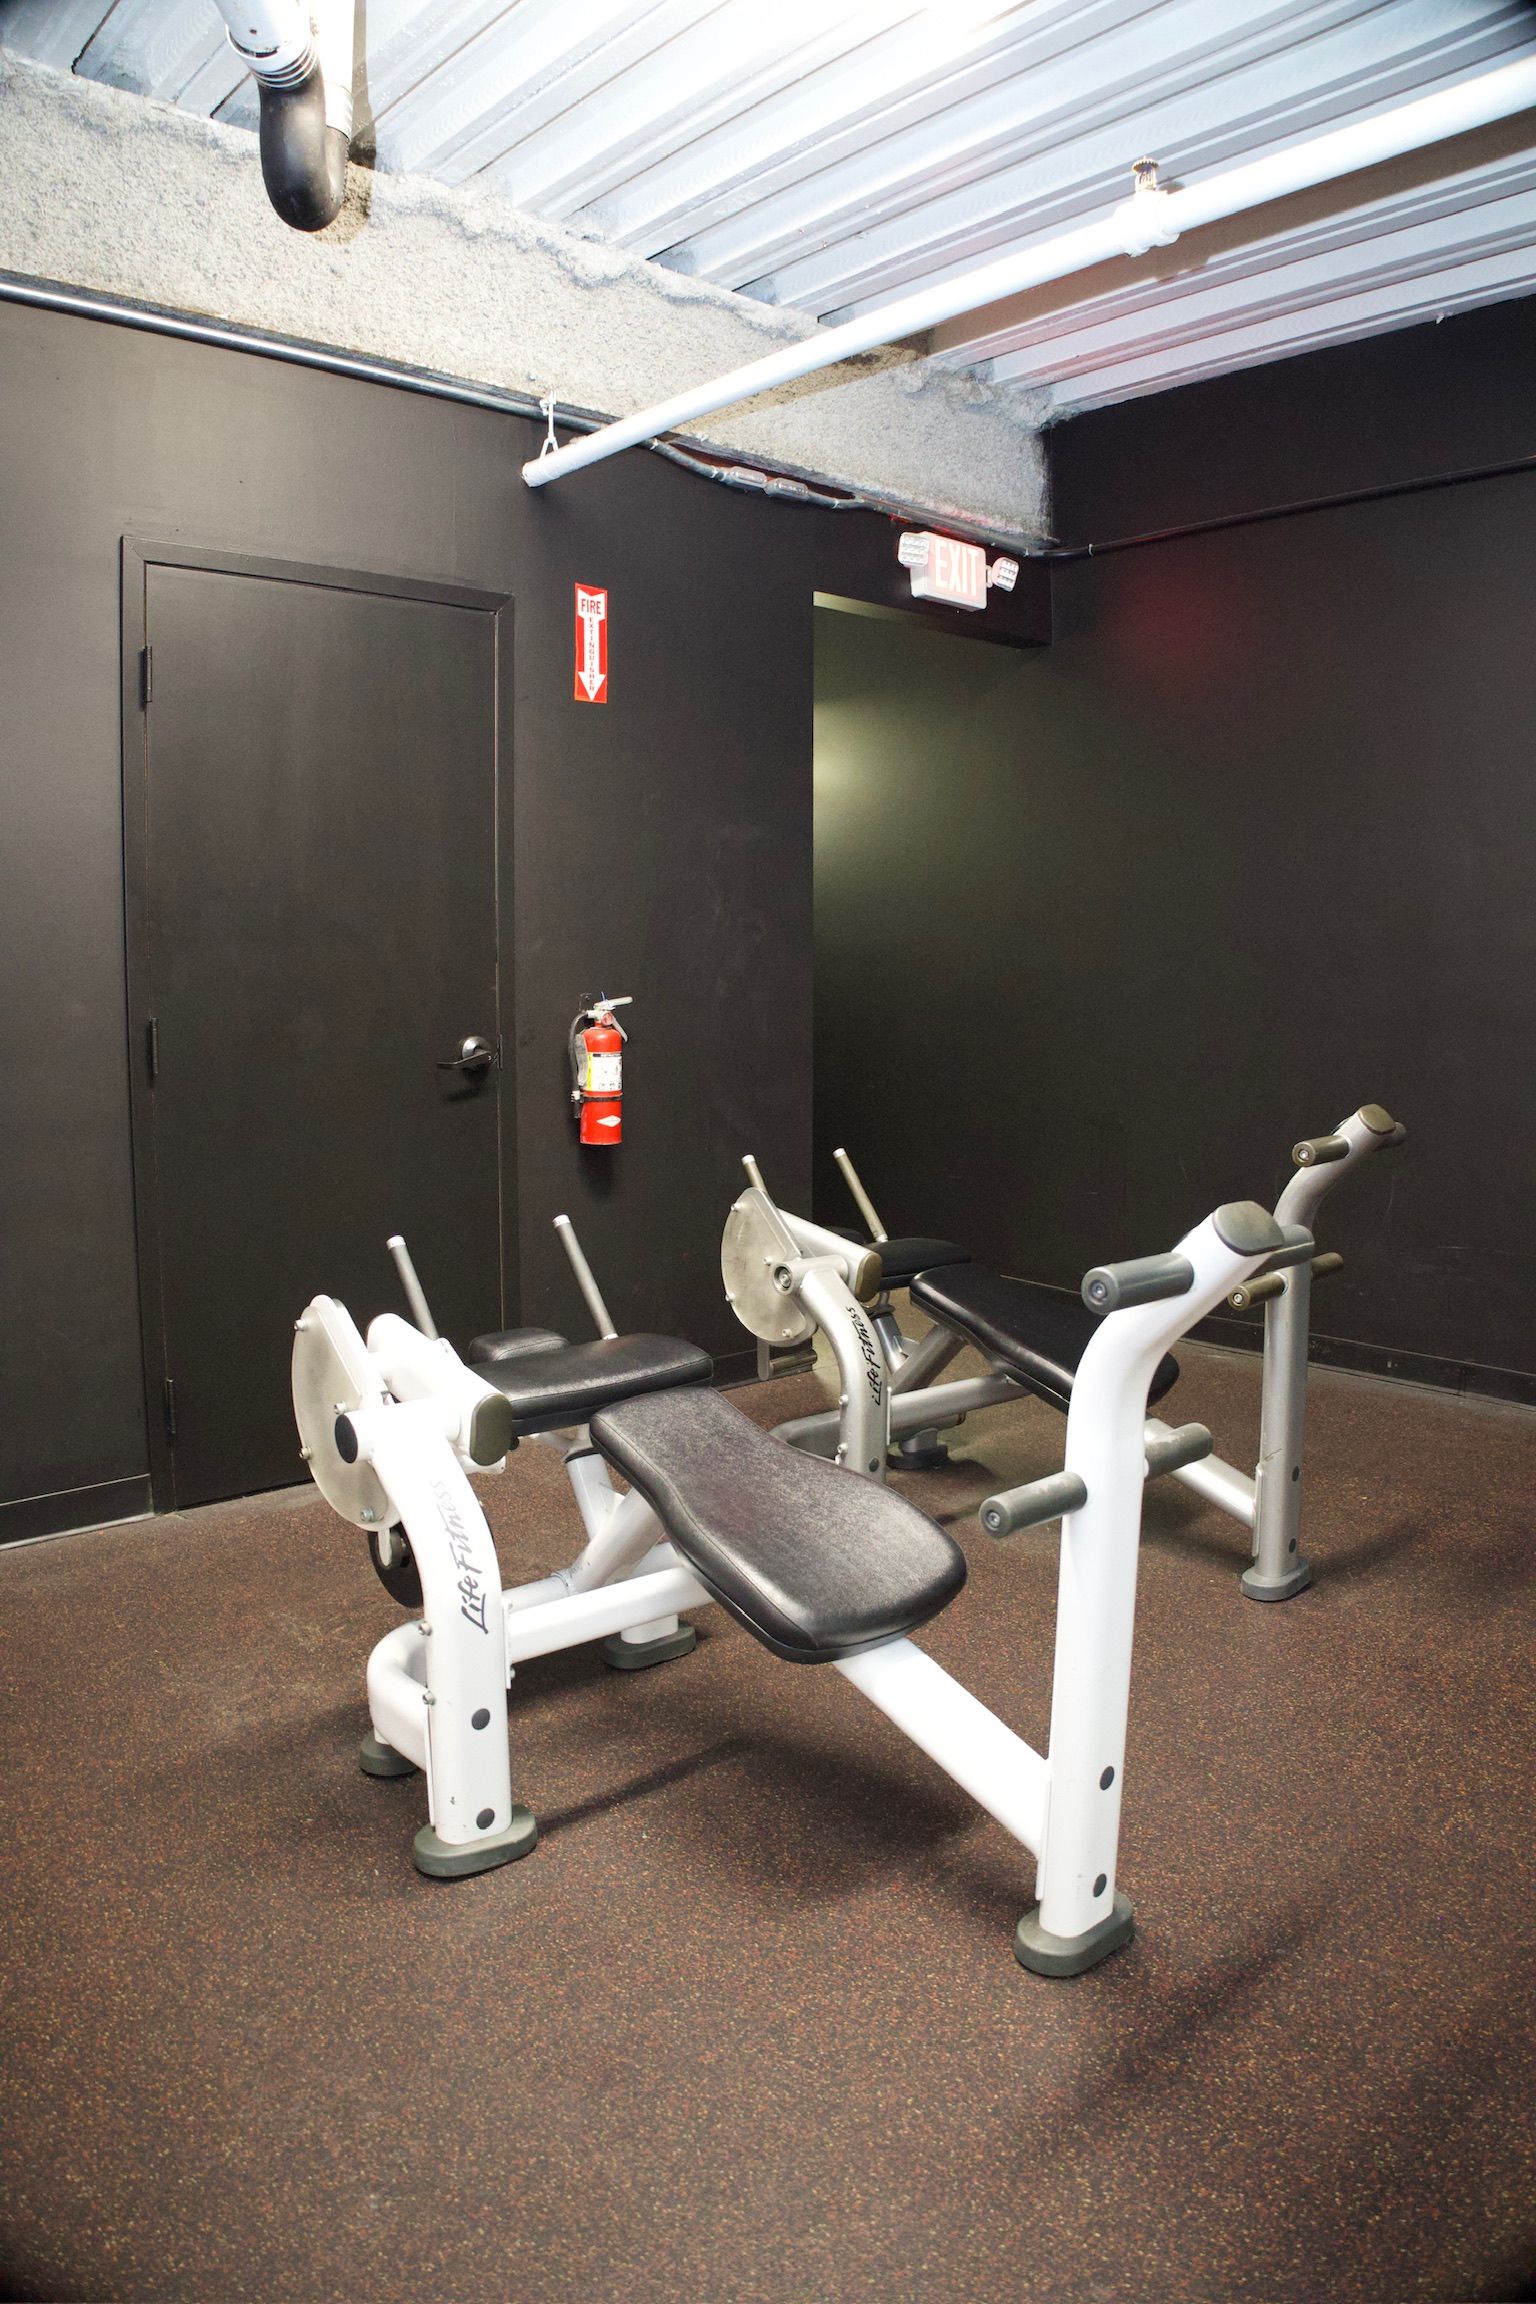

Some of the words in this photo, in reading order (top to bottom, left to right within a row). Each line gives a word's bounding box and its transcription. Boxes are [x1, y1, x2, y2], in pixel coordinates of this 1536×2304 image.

[934, 538, 980, 597] EXIT
[580, 598, 602, 615] FIRE
[588, 616, 596, 692] EXTINGUISHER
[457, 1574, 489, 1635] Life
